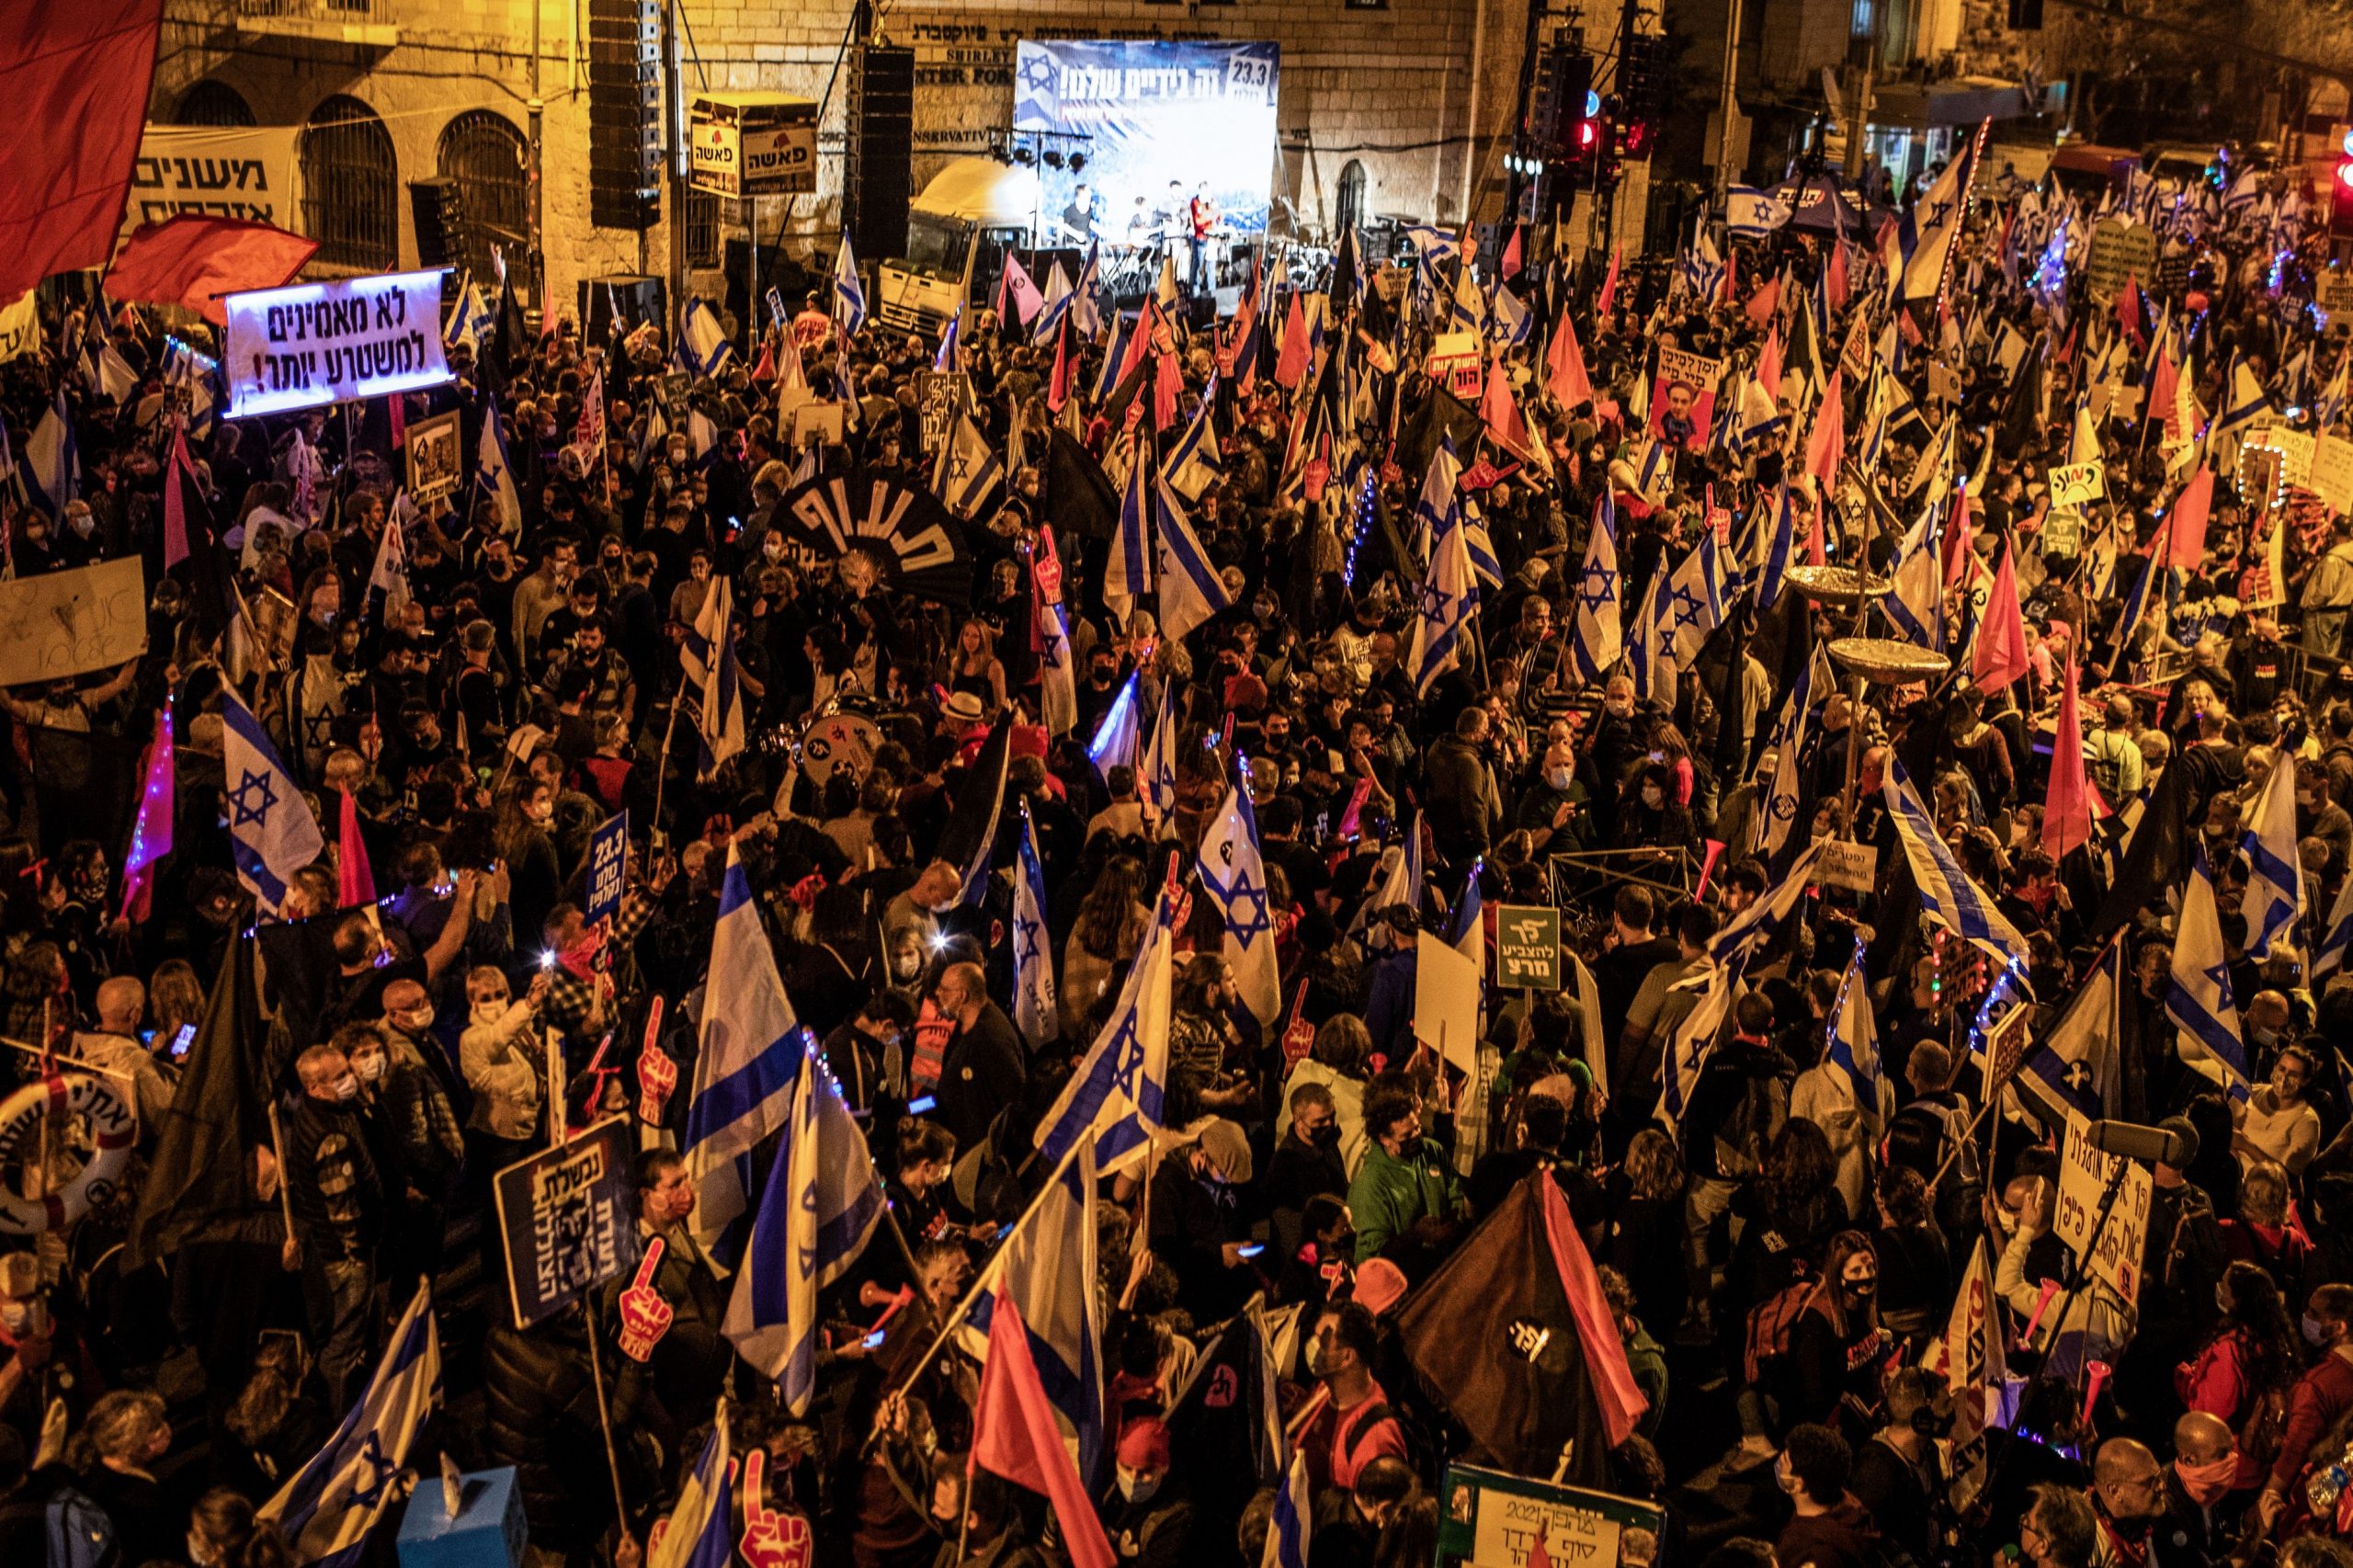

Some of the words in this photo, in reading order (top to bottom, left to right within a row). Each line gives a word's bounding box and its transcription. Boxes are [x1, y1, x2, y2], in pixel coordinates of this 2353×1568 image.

[947, 49, 1010, 62] SHIRLEY
[915, 67, 965, 84] NTER
[972, 67, 1011, 84] FOR
[1060, 63, 1120, 100] שלנו!
[1124, 66, 1189, 100] בידיים
[1196, 67, 1221, 99] זה
[1232, 60, 1267, 86] 23.3
[913, 130, 992, 142] NSERVATIV
[695, 146, 733, 162] פאשה
[748, 147, 807, 170] פאשה
[133, 157, 268, 191] משנים
[267, 295, 368, 343] מאמינים
[376, 285, 405, 330] לא
[324, 329, 426, 385] למשטרע
[253, 351, 317, 394] יותר!
[594, 827, 624, 870] 23.3
[1509, 919, 1549, 945] לך
[1502, 944, 1554, 959] להצביע
[1506, 958, 1551, 977] מרצ
[533, 1200, 558, 1303] הצוללו
[1506, 1500, 1541, 1525] 2021
[1563, 1540, 1597, 1562] סוף
